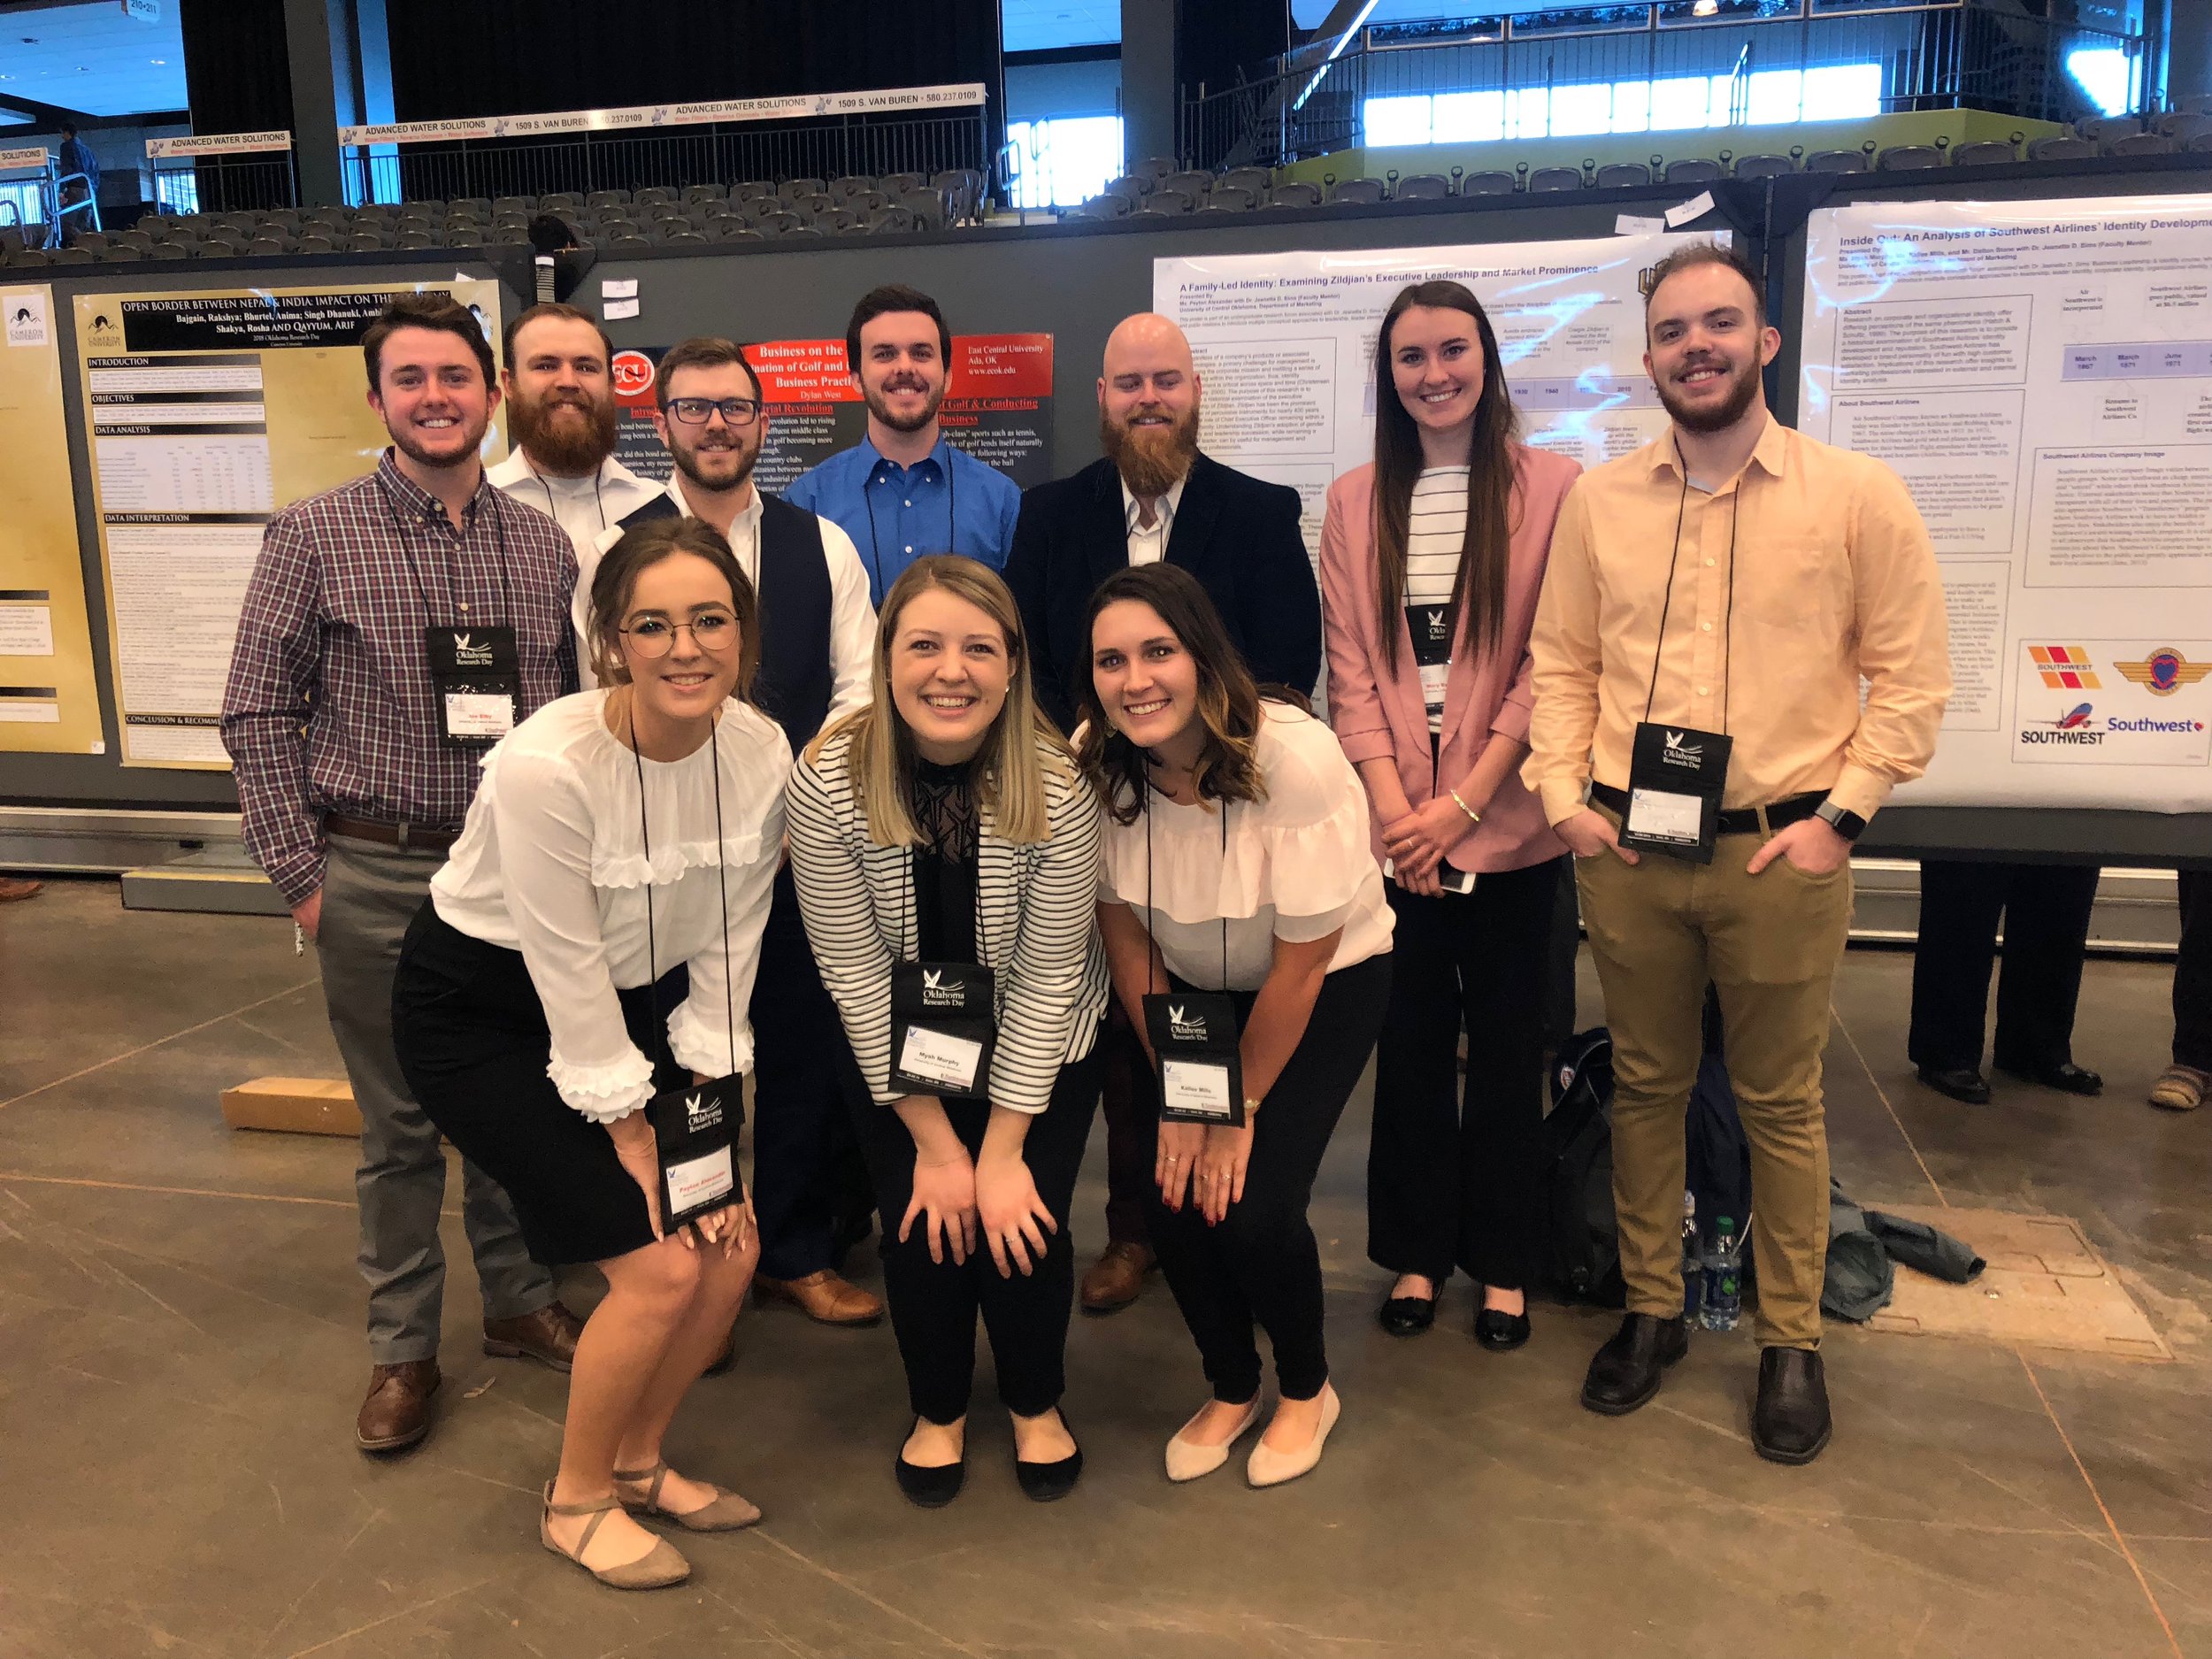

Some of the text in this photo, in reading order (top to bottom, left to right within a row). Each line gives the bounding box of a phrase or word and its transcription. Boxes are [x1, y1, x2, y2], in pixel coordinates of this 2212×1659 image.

[676, 99, 807, 114] ADVANCED WATER SOLUTIONS
[839, 99, 856, 108] 1509
[858, 97, 867, 106] S.
[868, 96, 887, 106] VAN
[888, 94, 918, 104] BUREN
[365, 126, 408, 134] ADVANCED
[441, 120, 486, 131] SOLUTIONS
[561, 118, 588, 127] BUREN
[172, 133, 285, 147] ADVANCED WATER SOLUTIONS
[2, 150, 41, 160] SOLUTIONS
[1840, 237, 1874, 246] Inside
[1922, 231, 1970, 242] Analysis
[1989, 226, 2049, 237] Southwest
[2104, 221, 2147, 231] Identity
[1189, 281, 1237, 292] Family-Led
[1240, 280, 1277, 290] Identity:
[1279, 278, 1327, 287] Examining
[1331, 274, 1372, 285] Zildjian's
[1376, 272, 1423, 282] Executive
[1425, 269, 1479, 281] Leadership
[1481, 269, 1499, 278] and
[1502, 267, 1536, 276] Market
[1540, 265, 1598, 276] Prominence
[123, 303, 149, 311] OPEN
[152, 301, 191, 311] BORDER
[193, 299, 237, 310] BETWEEN
[239, 298, 271, 309] NEPAL
[282, 297, 313, 307] INDIA:
[316, 295, 352, 306] IMPACT
[354, 295, 370, 304] ON
[177, 315, 206, 324] Bajgain,
[209, 313, 242, 324] Rakshya;
[244, 312, 274, 322] Bhurtel,
[276, 311, 303, 320] Anima;
[304, 310, 326, 320] Singh
[217, 324, 245, 334] Shakya,
[248, 324, 270, 333] Rosha
[272, 323, 290, 333] AND
[335, 320, 355, 330] ARIF
[760, 345, 805, 357] Business
[826, 344, 842, 356] the
[984, 345, 1007, 354] Central
[1009, 345, 1044, 354] University
[88, 357, 149, 366] INTRODUCTION
[787, 361, 842, 372] of Golf and
[986, 356, 997, 365] OK
[612, 364, 648, 382] ECU
[776, 376, 851, 388] Business Practi
[92, 395, 134, 403] OBJECTIVES
[801, 391, 821, 400] Dylan
[786, 403, 833, 414] Revolution
[949, 398, 1039, 410] Golf Conducting
[940, 414, 979, 425] Business
[126, 715, 175, 724] CONCLUSION
[2108, 718, 2193, 733] Southwest
[2021, 731, 2106, 745] SOUTHWEST
[1663, 750, 1701, 763] Oklahoma
[1663, 757, 1701, 772] Research Day
[924, 990, 964, 1000] Oklahoma
[1171, 1025, 1207, 1035] Oklahoma
[937, 1056, 959, 1066] Murphy
[688, 1108, 722, 1126] Oklahoma
[689, 1117, 723, 1134] Research Day
